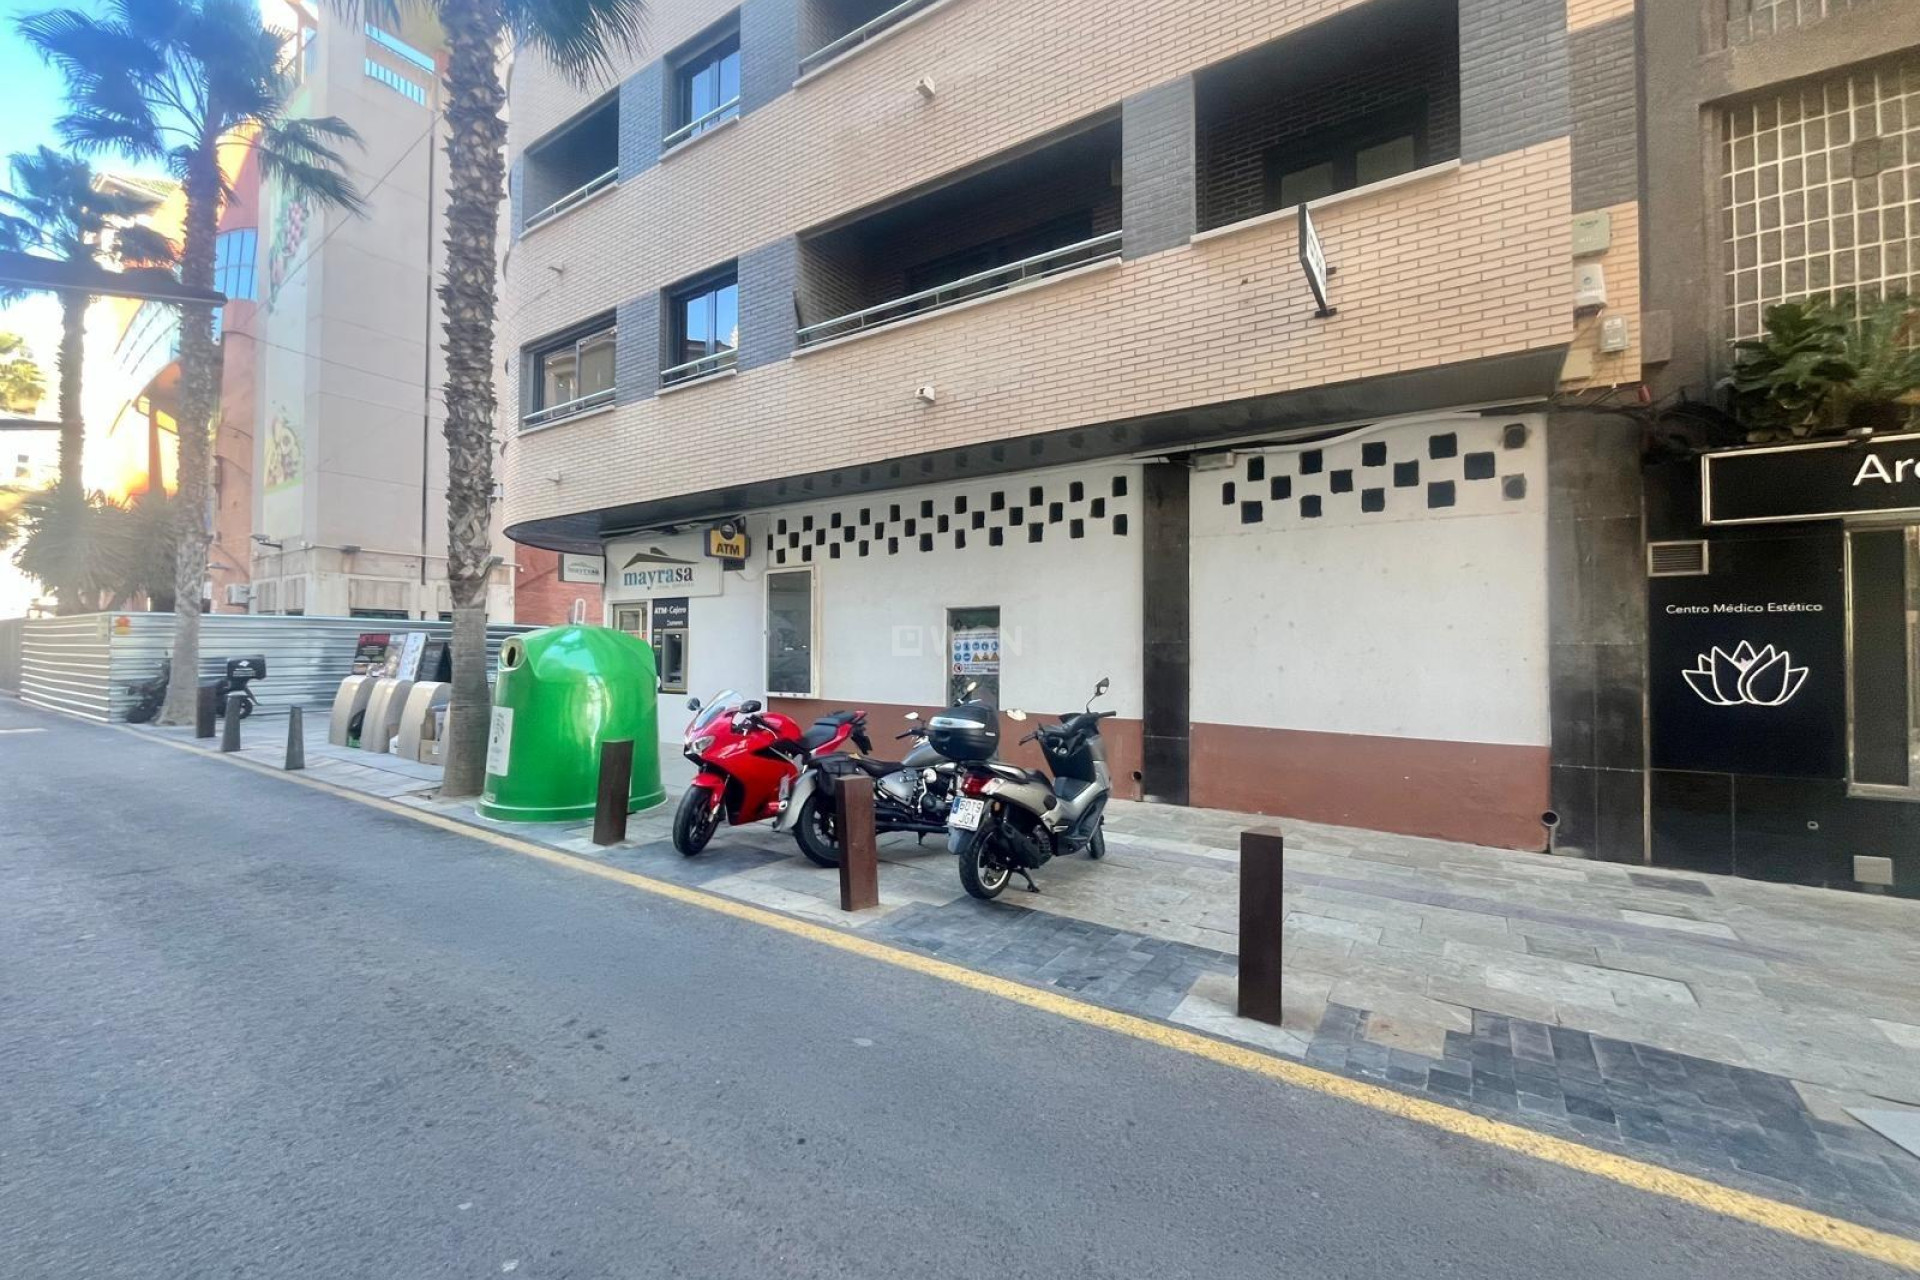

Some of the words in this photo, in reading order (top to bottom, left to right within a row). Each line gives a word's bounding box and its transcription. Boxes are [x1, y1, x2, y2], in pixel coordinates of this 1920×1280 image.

[716, 542, 740, 556] ATM
[623, 566, 694, 591] mayrasa
[1665, 604, 1710, 614] Centro
[1713, 603, 1764, 613] Médico
[1767, 602, 1824, 612] Estético
